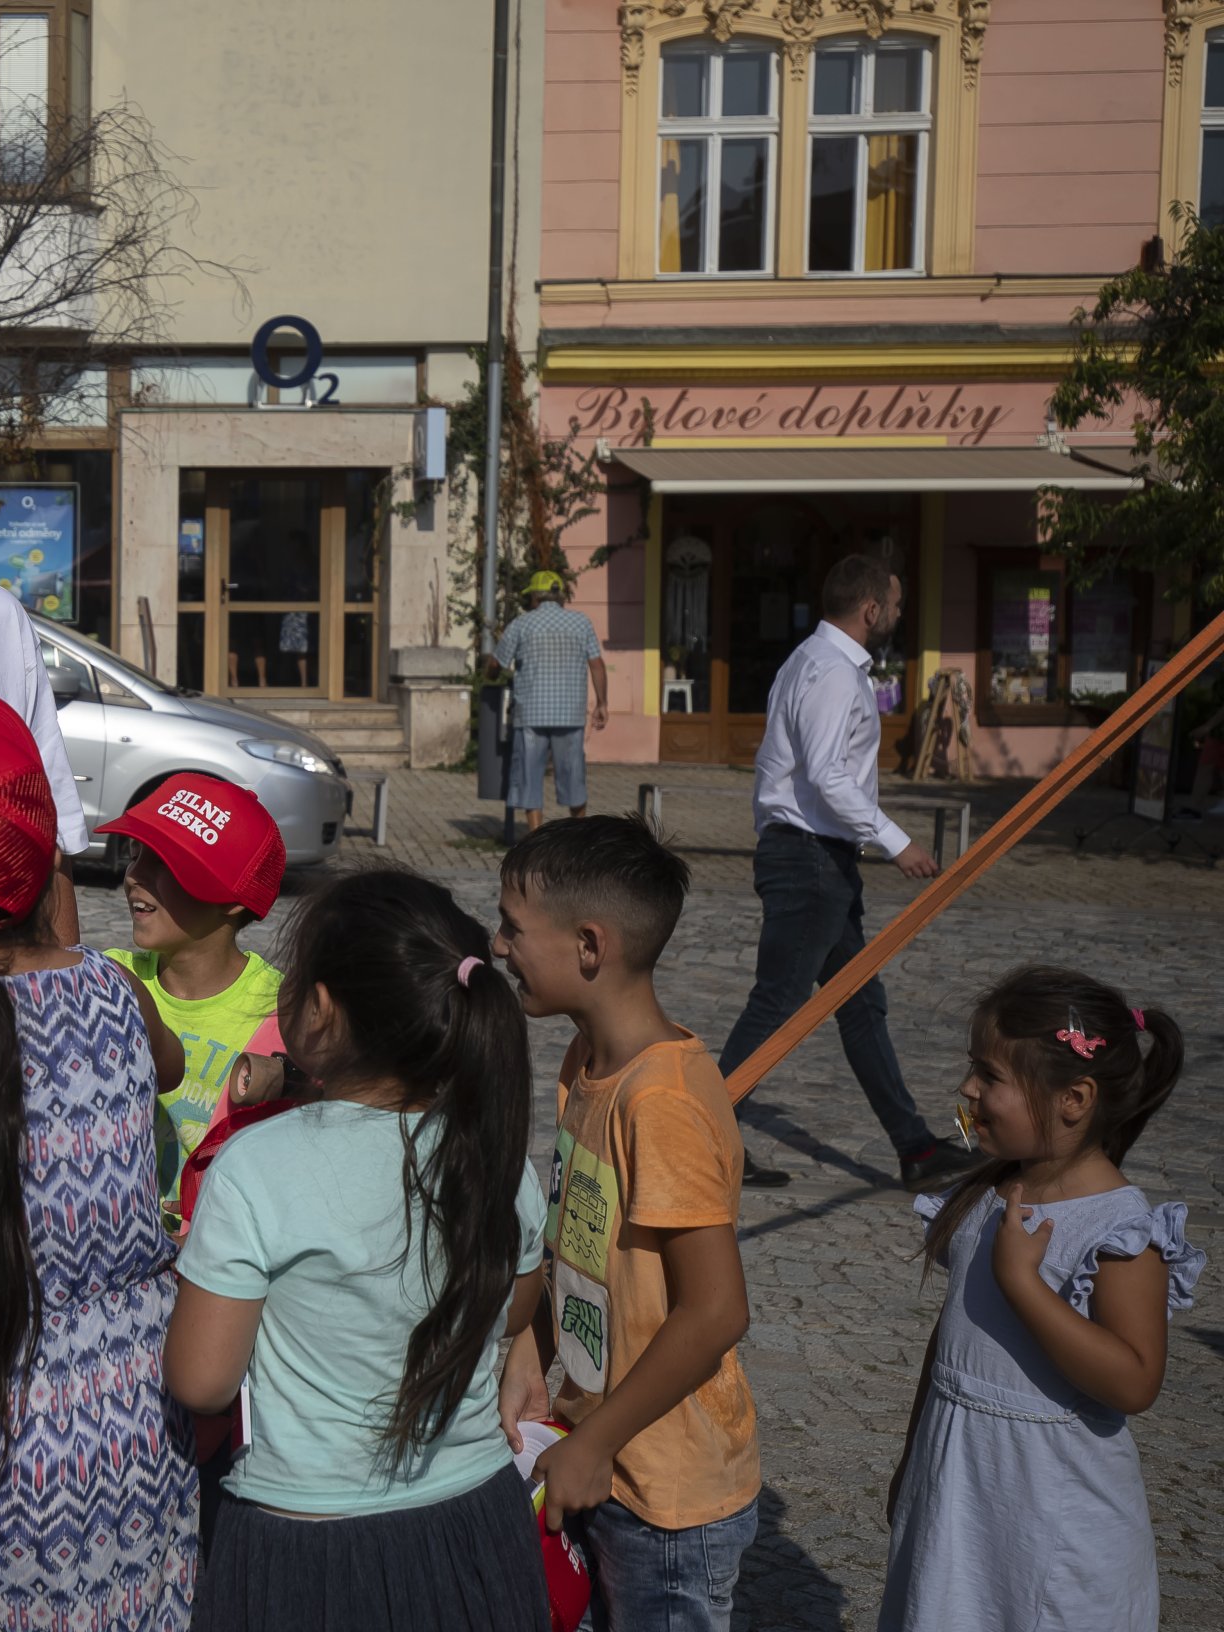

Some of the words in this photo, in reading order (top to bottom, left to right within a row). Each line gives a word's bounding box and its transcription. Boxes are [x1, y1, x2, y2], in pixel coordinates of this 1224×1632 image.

[779, 384, 1014, 446] doplňky
[19, 527, 62, 541] odměny
[157, 799, 219, 845] ČESKO
[170, 789, 232, 831] SILNÉ
[565, 1294, 603, 1340] SUN
[561, 1311, 602, 1371] FUN
